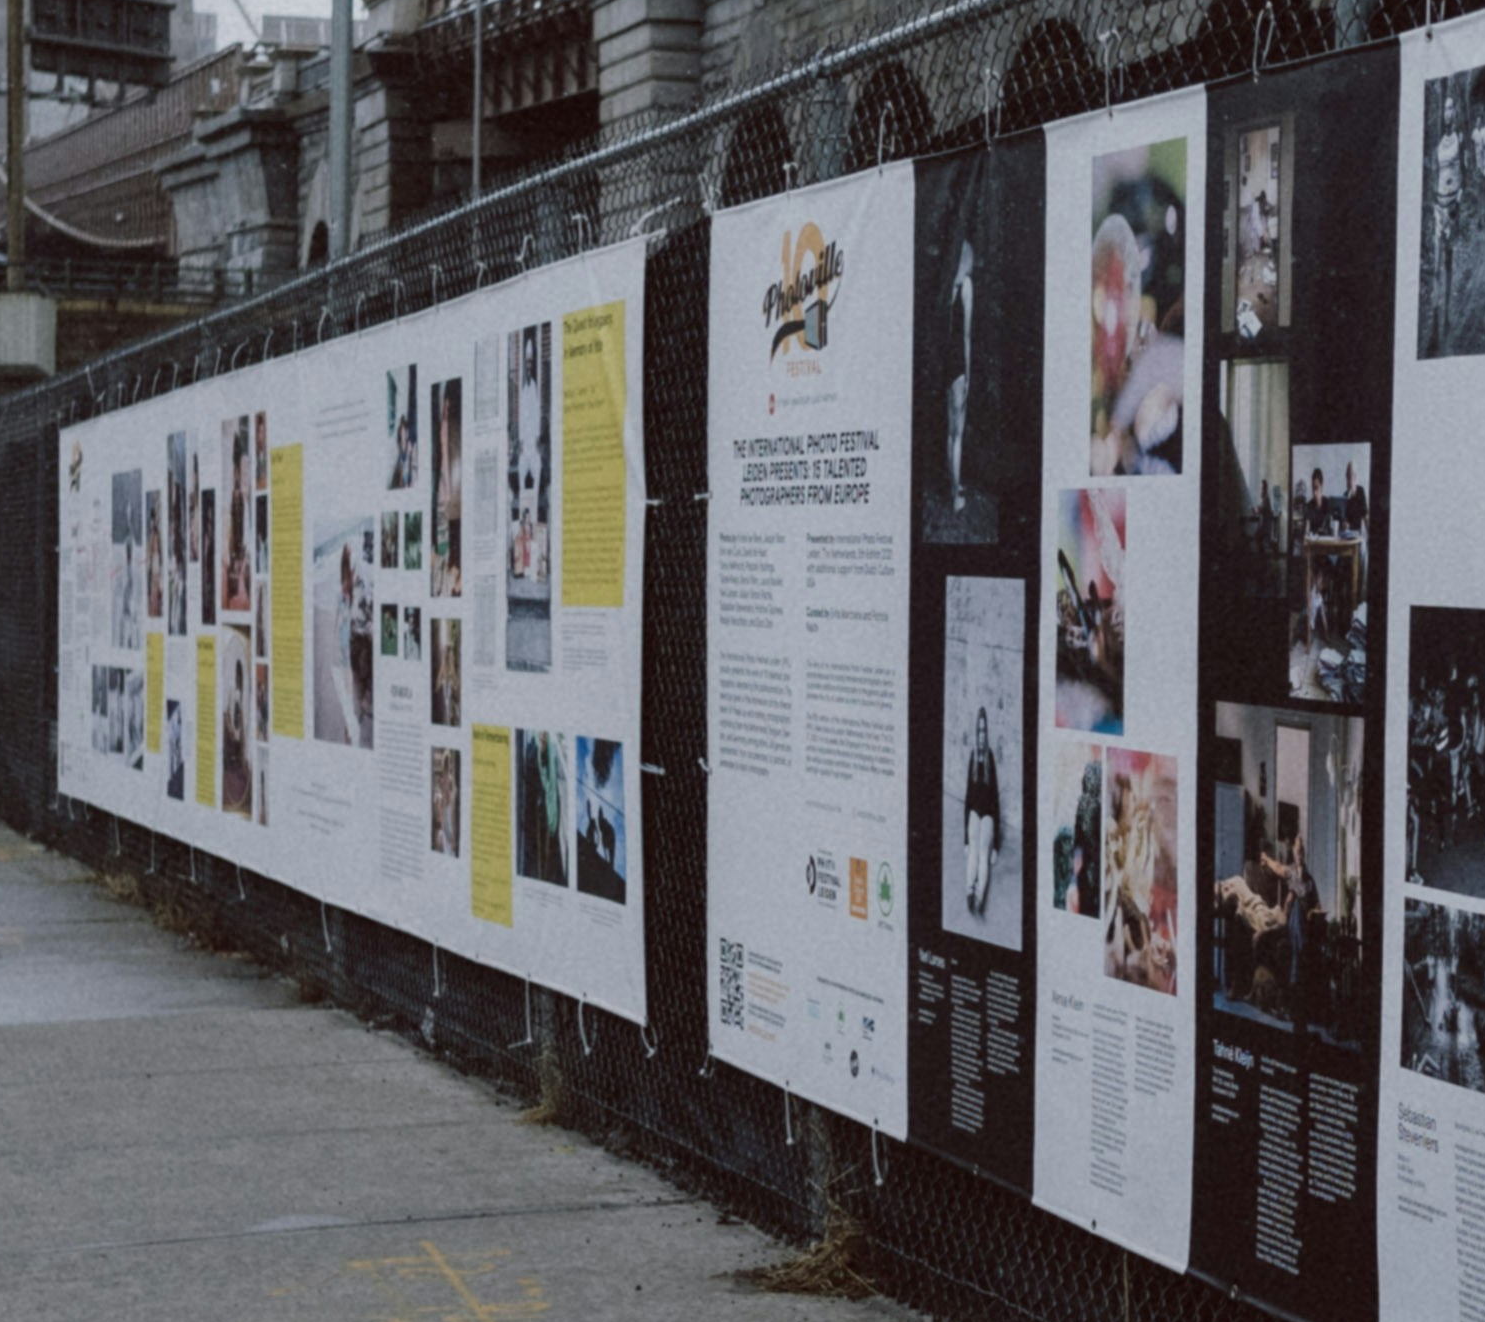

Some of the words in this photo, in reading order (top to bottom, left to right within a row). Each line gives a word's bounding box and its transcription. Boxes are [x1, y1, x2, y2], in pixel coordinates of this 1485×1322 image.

[763, 241, 844, 329] Photoville
[734, 439, 746, 458] THE
[748, 435, 805, 457] INTERNATIONAL
[807, 433, 837, 454] PHOTO
[840, 430, 880, 452] FESTIVAL
[824, 457, 867, 479] TALENTED
[740, 486, 805, 506] PHOTOGRAPHERS
[807, 485, 833, 505] FROM
[835, 483, 870, 504] EUROPE
